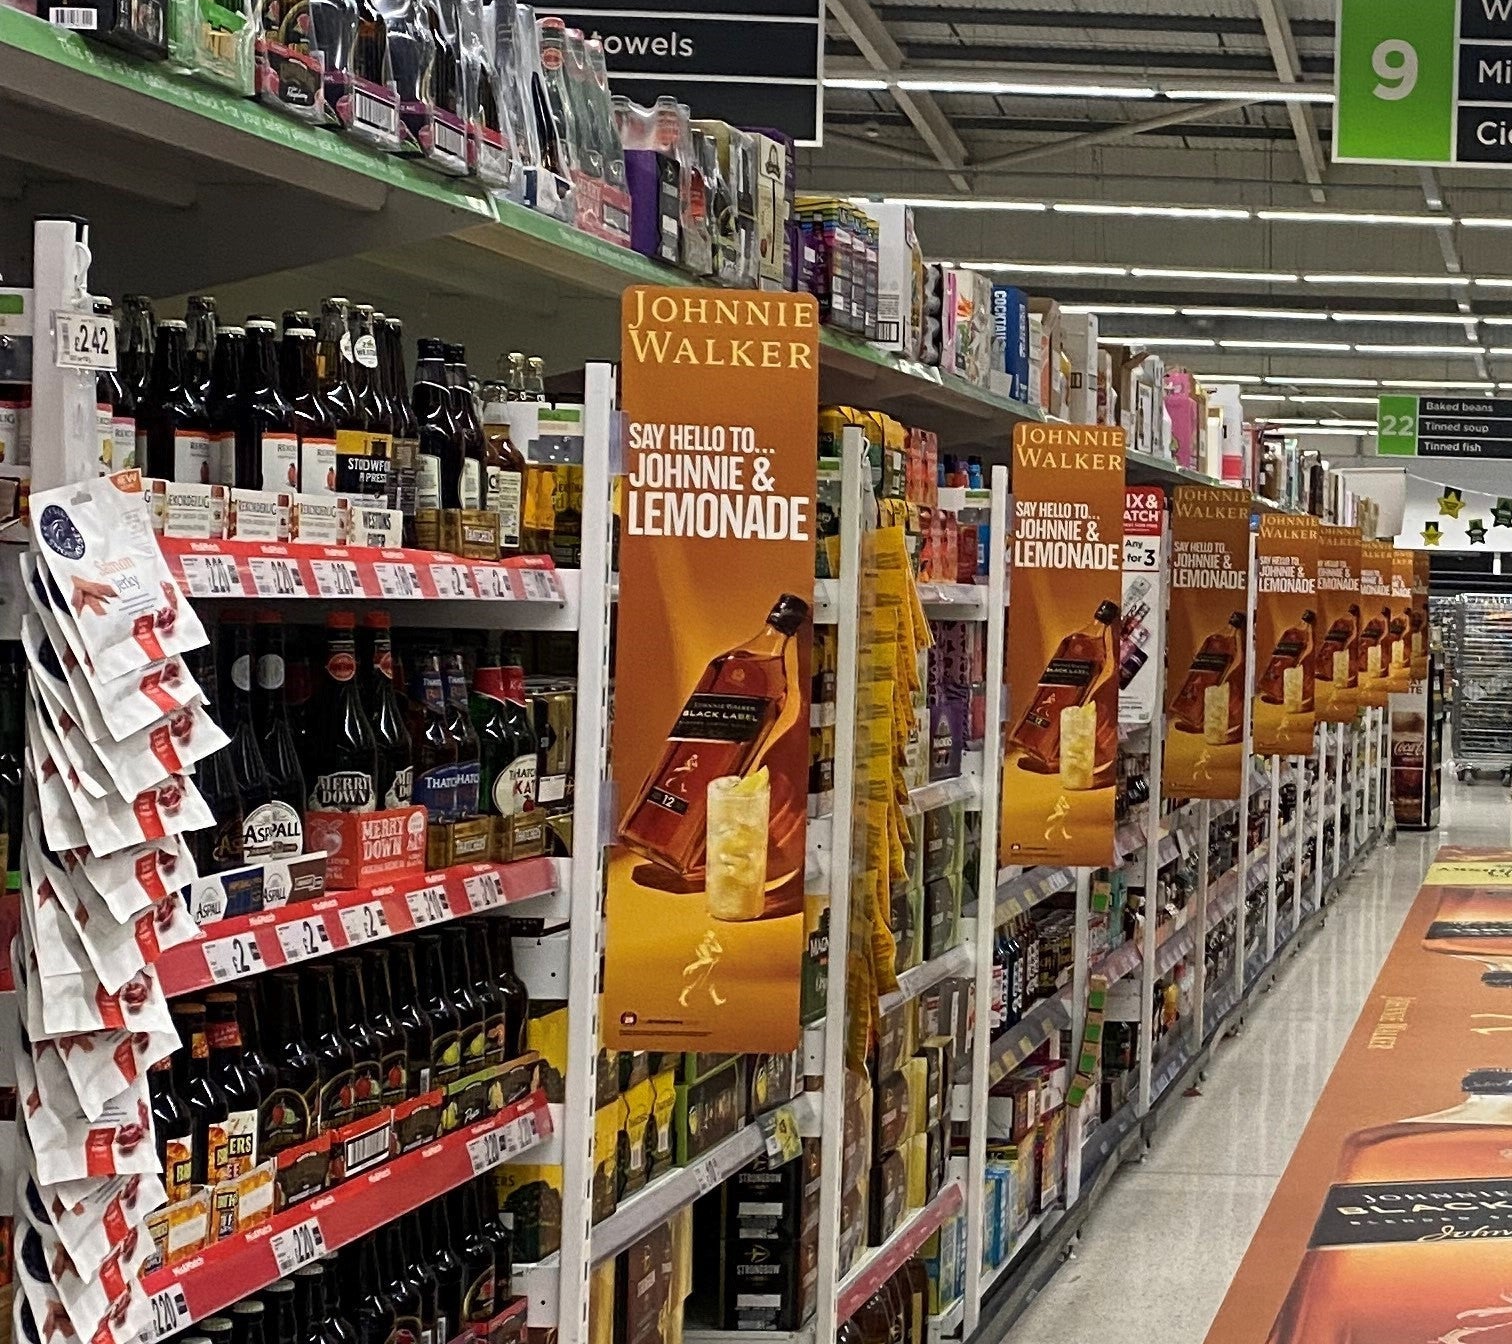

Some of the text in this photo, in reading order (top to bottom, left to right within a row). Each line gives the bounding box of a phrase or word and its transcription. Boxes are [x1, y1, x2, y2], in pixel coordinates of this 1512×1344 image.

[1372, 39, 1419, 101] 9
[629, 290, 813, 329] JOHNNIE
[74, 324, 109, 355] £2.42
[629, 329, 812, 369] WALKER
[1426, 402, 1493, 412] Baked beans
[1020, 425, 1123, 447] JOHNNIE
[1381, 415, 1414, 436] 22
[1425, 422, 1489, 433] Tinned soup
[629, 422, 775, 454] SAY HELLO TO...
[1424, 441, 1481, 452] Tinned fish
[1016, 444, 1122, 471] WALKER
[629, 453, 775, 492] JOHNNIE &
[1016, 501, 1100, 520] SAY HELLO TO...
[1126, 494, 1157, 509] IX &
[628, 491, 809, 541] LEMONADE
[1123, 510, 1159, 522] ATCH
[1016, 519, 1100, 541] JOHNNIE &
[1125, 540, 1143, 549] Any
[1015, 541, 1119, 570] LEMONADE
[1127, 549, 1155, 566] for 3
[1174, 553, 1232, 569] JOHNNIE &
[115, 570, 141, 596] Jerky
[1173, 569, 1246, 590] LEMONADE
[683, 709, 759, 722] BLACK LABEL
[322, 790, 367, 804] DOWN
[661, 795, 675, 808] 12
